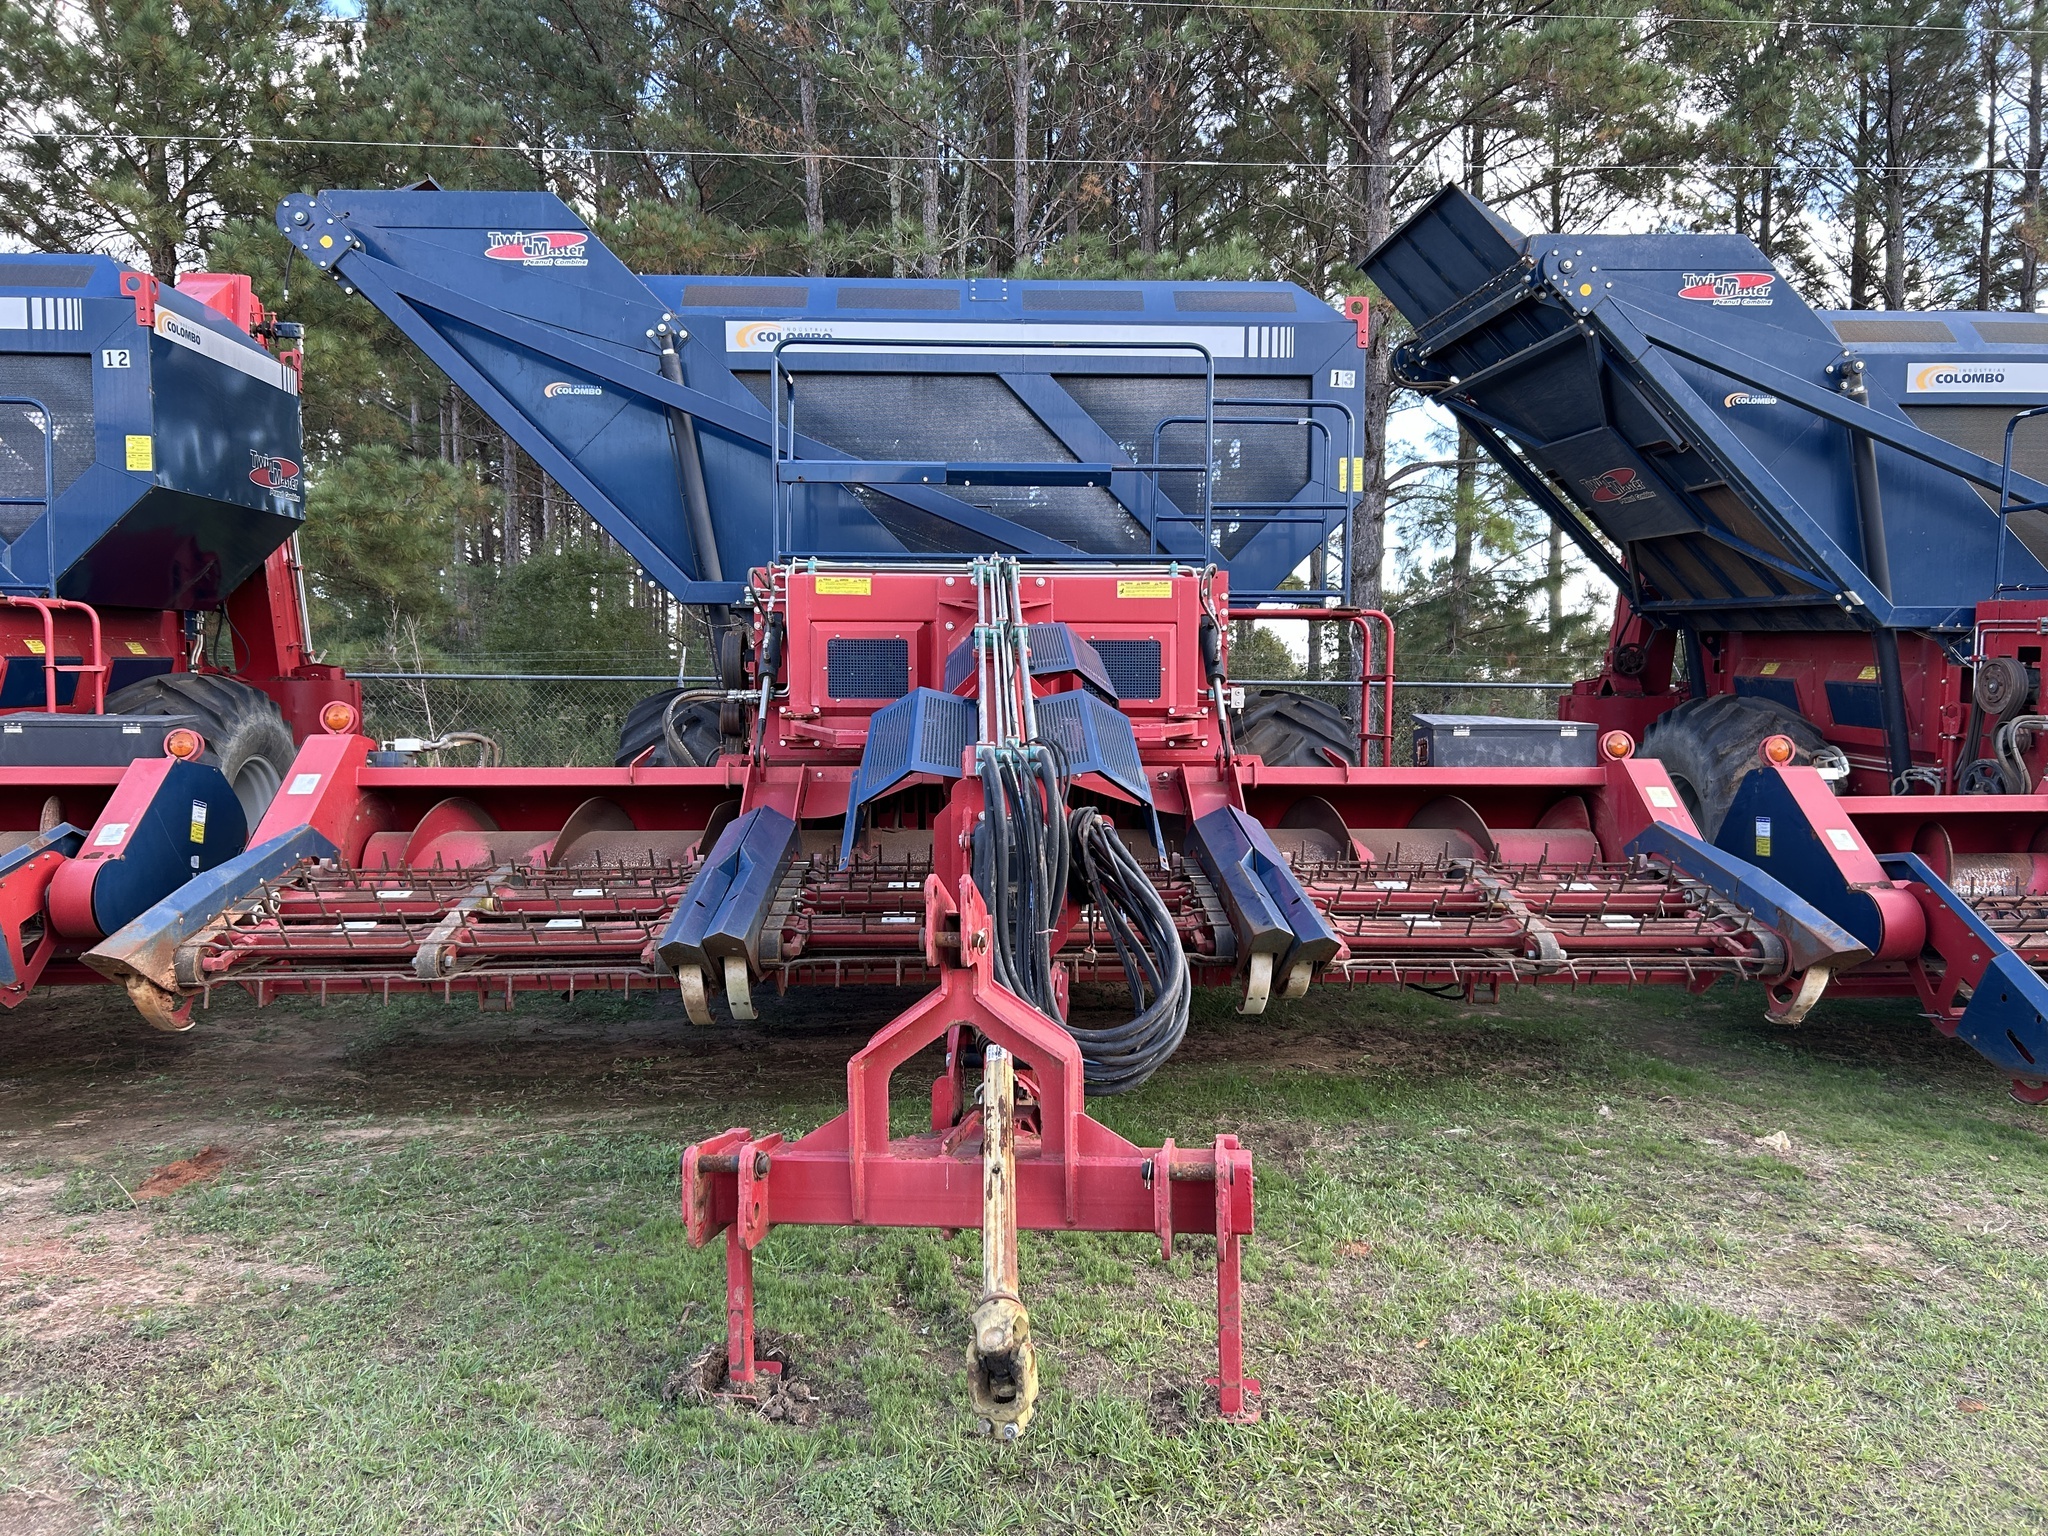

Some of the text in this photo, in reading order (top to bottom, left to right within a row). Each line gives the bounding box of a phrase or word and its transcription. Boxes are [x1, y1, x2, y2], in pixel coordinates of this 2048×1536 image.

[488, 232, 585, 257] Twin Master
[554, 258, 588, 266] Combine
[1683, 273, 1771, 297] Twin Master
[1741, 298, 1773, 306] Combine
[167, 321, 201, 345] COLOMBO
[106, 351, 128, 366] 12
[1333, 371, 1354, 386] 13
[1935, 373, 2005, 384] COLOMBO
[556, 387, 602, 395] COLOMBO
[1735, 397, 1777, 405] COLOMBO
